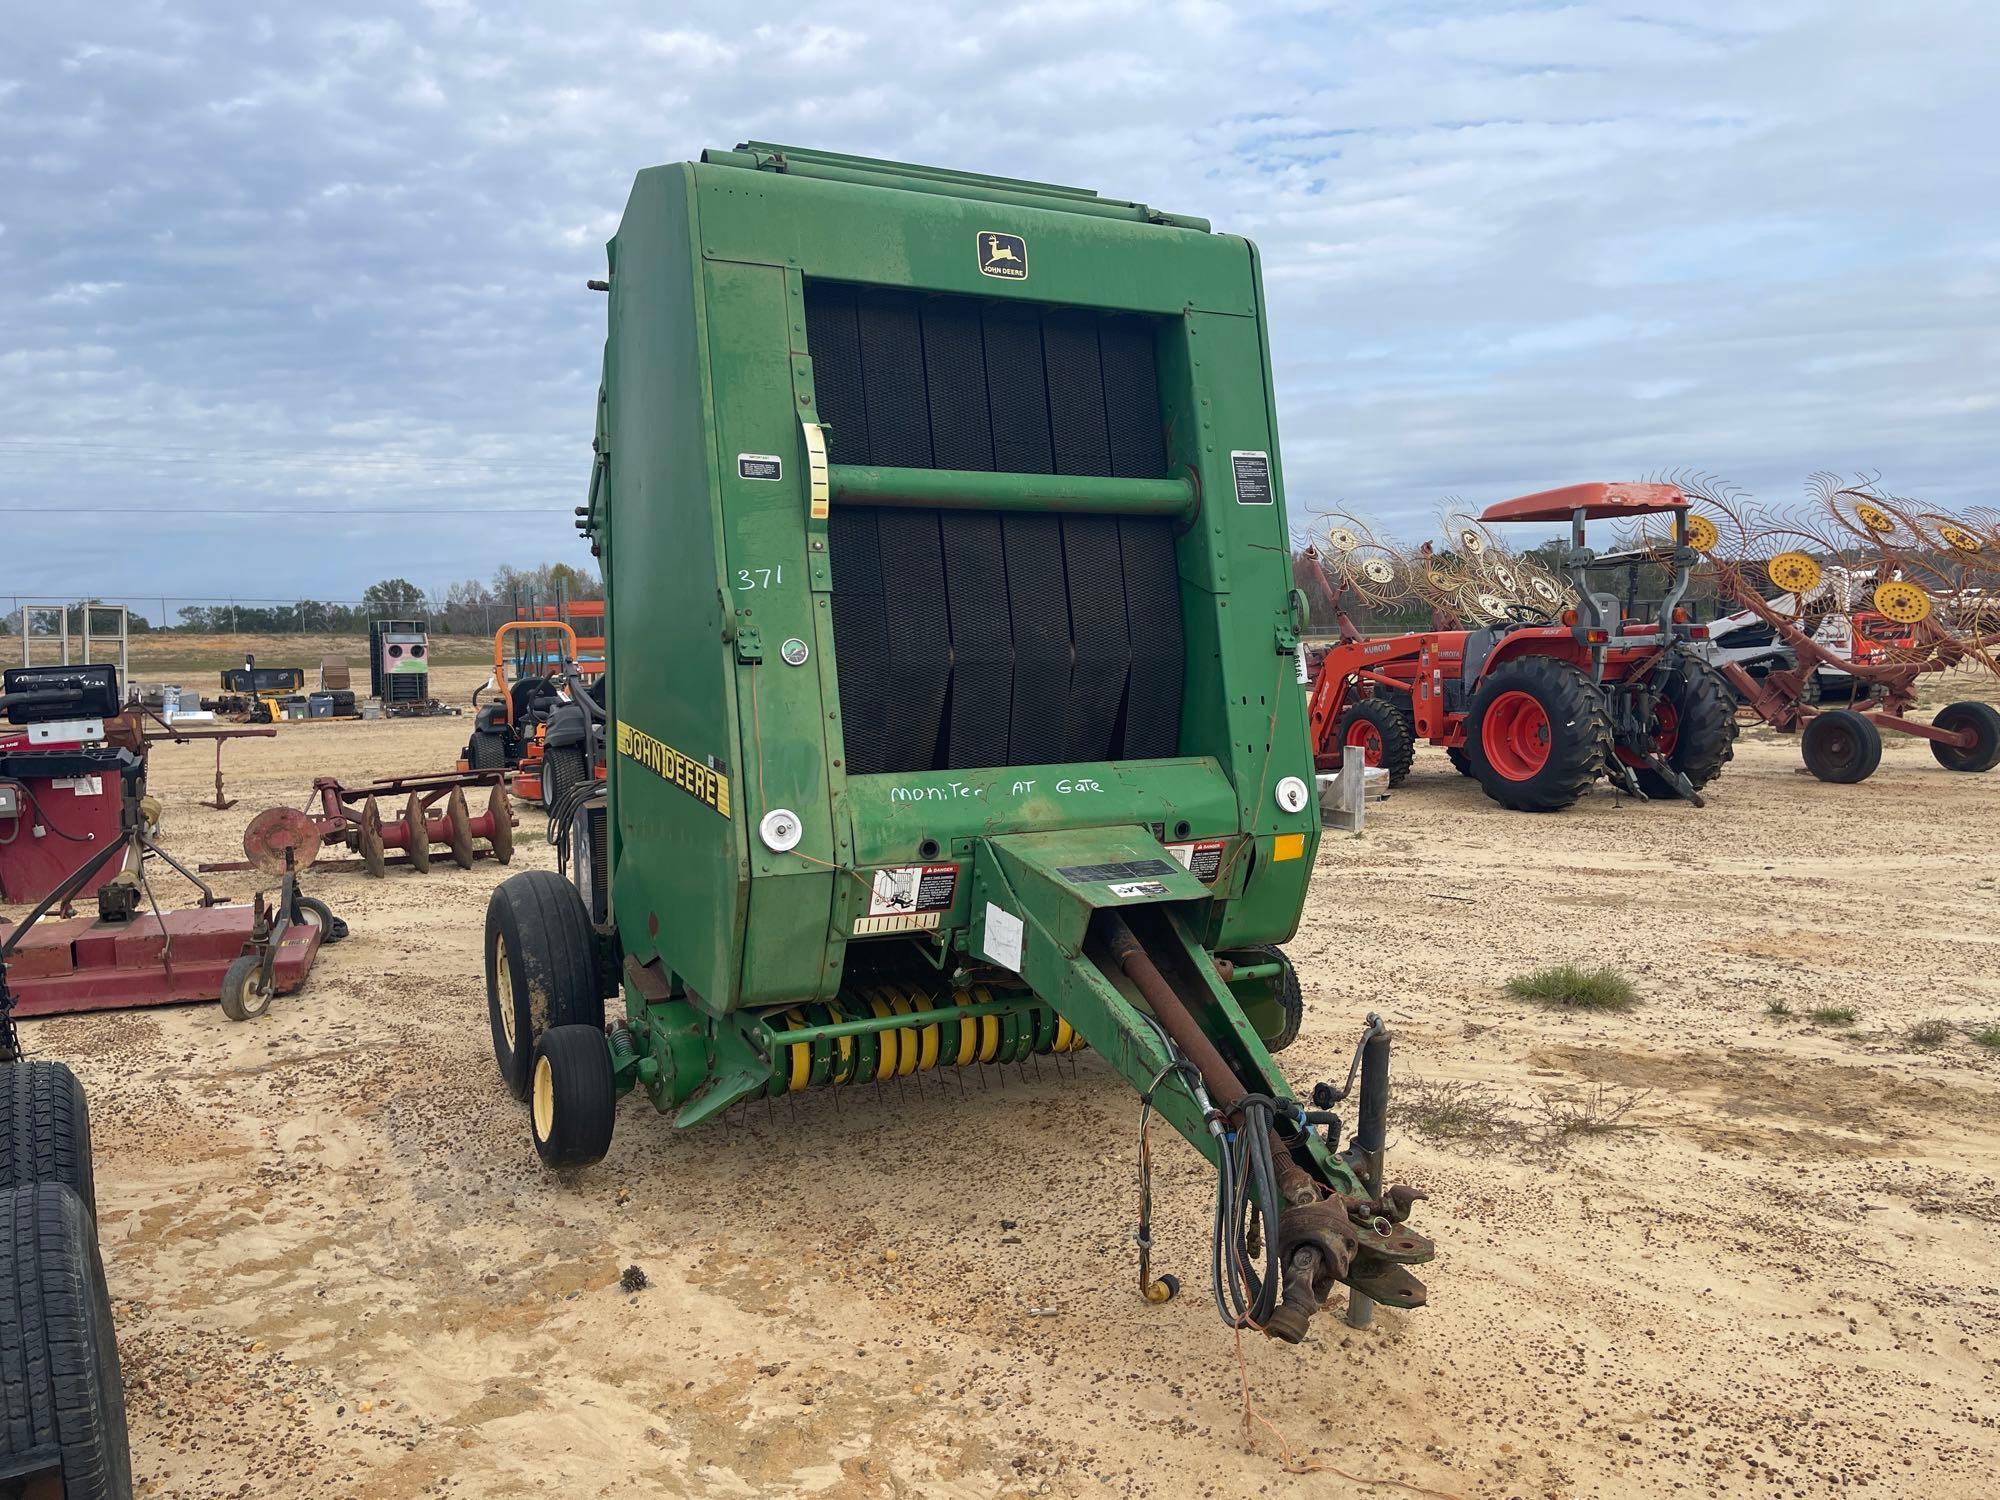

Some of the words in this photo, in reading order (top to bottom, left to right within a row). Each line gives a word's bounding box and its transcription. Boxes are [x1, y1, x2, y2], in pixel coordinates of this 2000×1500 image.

[984, 265, 1001, 274] JOHN
[1002, 267, 1024, 276] DEERE
[738, 564, 781, 590] 371
[1364, 643, 1391, 655] KUBOTA
[625, 728, 661, 774] JOHN
[664, 747, 718, 807] DEERE
[1012, 780, 1036, 796] AT
